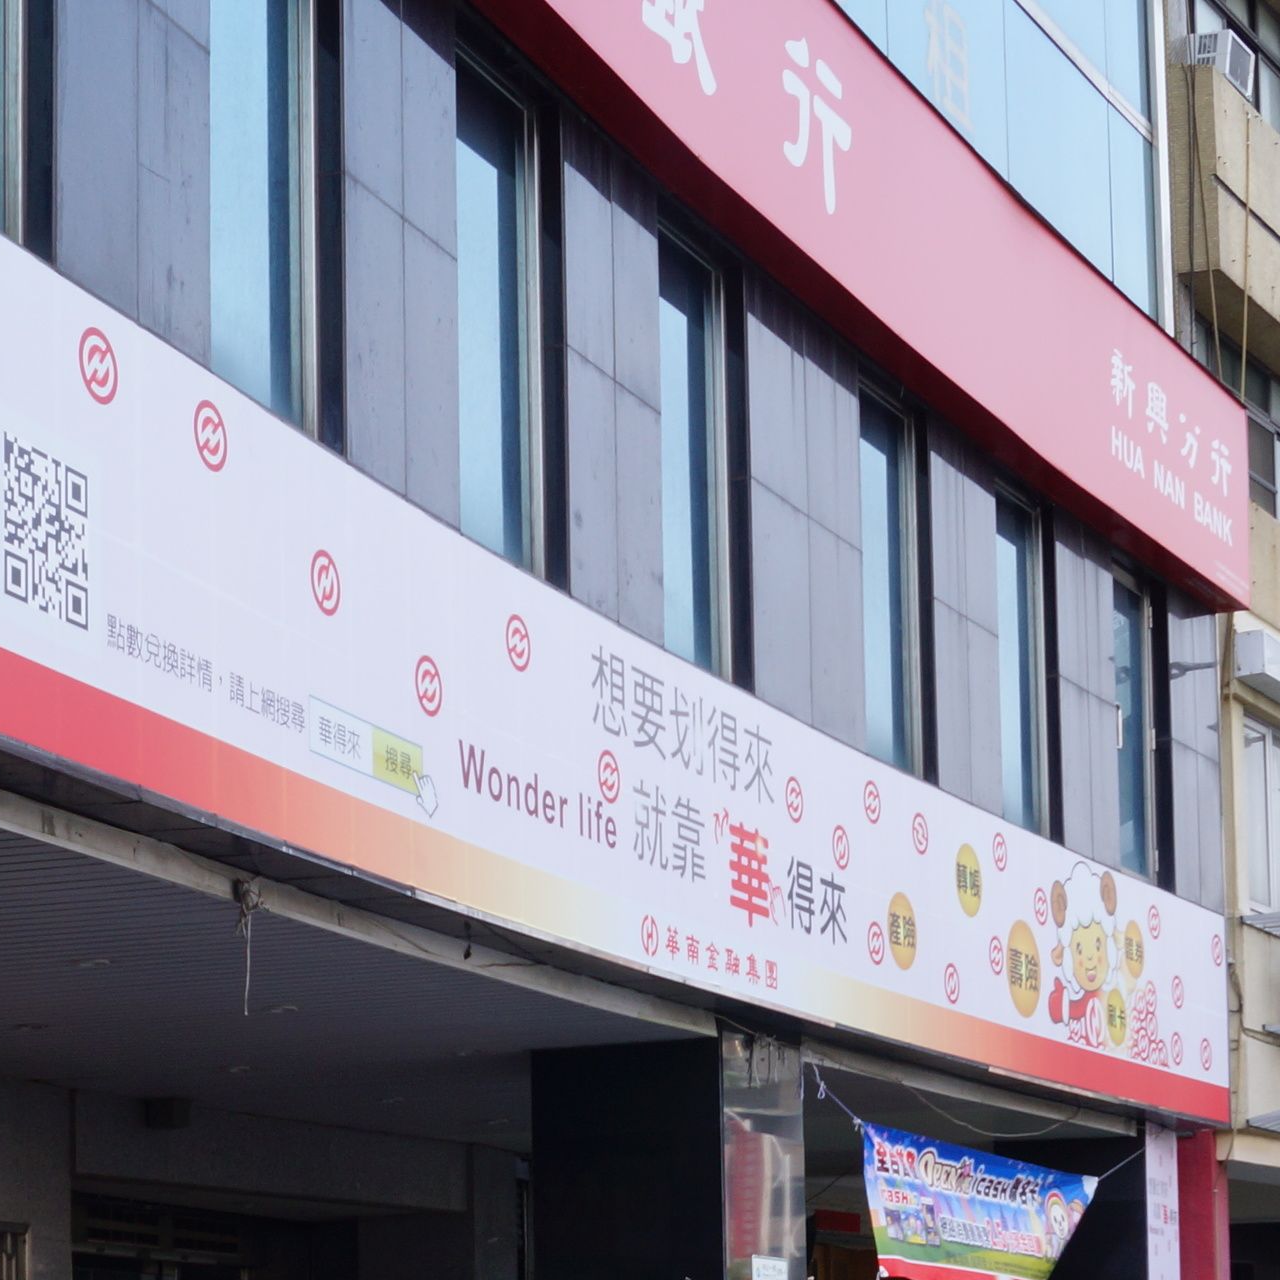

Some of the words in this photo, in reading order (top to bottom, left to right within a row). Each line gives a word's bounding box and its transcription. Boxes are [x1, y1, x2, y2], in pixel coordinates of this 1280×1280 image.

[1110, 348, 1233, 498] 新興分行
[1111, 424, 1146, 480] HUA
[1153, 459, 1186, 510] NAN
[1193, 490, 1234, 547] BANK
[591, 644, 776, 805] 想要划得來
[457, 738, 569, 831] Wonder
[578, 791, 618, 849] life
[665, 925, 778, 990] 華南金融集團
[888, 909, 917, 951] 產險
[1008, 947, 1040, 993] 壽險
